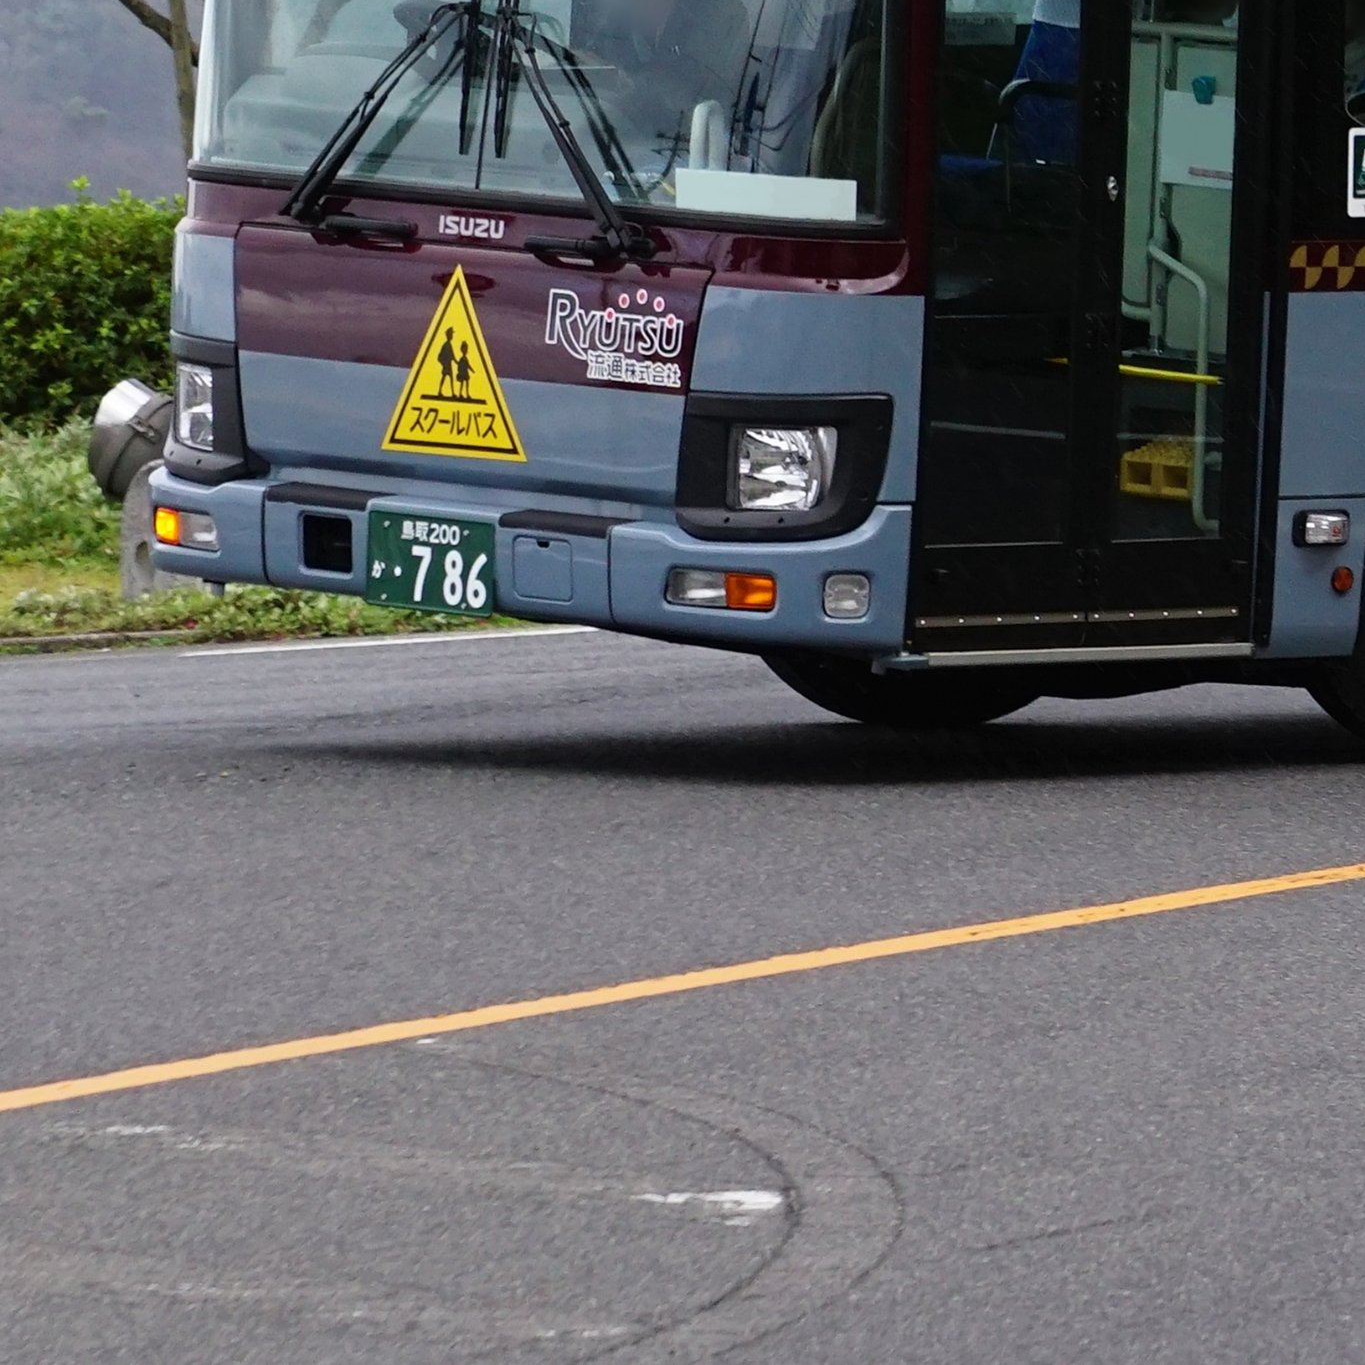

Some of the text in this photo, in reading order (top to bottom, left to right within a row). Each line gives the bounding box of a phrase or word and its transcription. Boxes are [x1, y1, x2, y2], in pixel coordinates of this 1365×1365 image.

[438, 215, 505, 240] ISUZU
[586, 349, 682, 388] 流通株式会社
[409, 406, 498, 439] スクールバス
